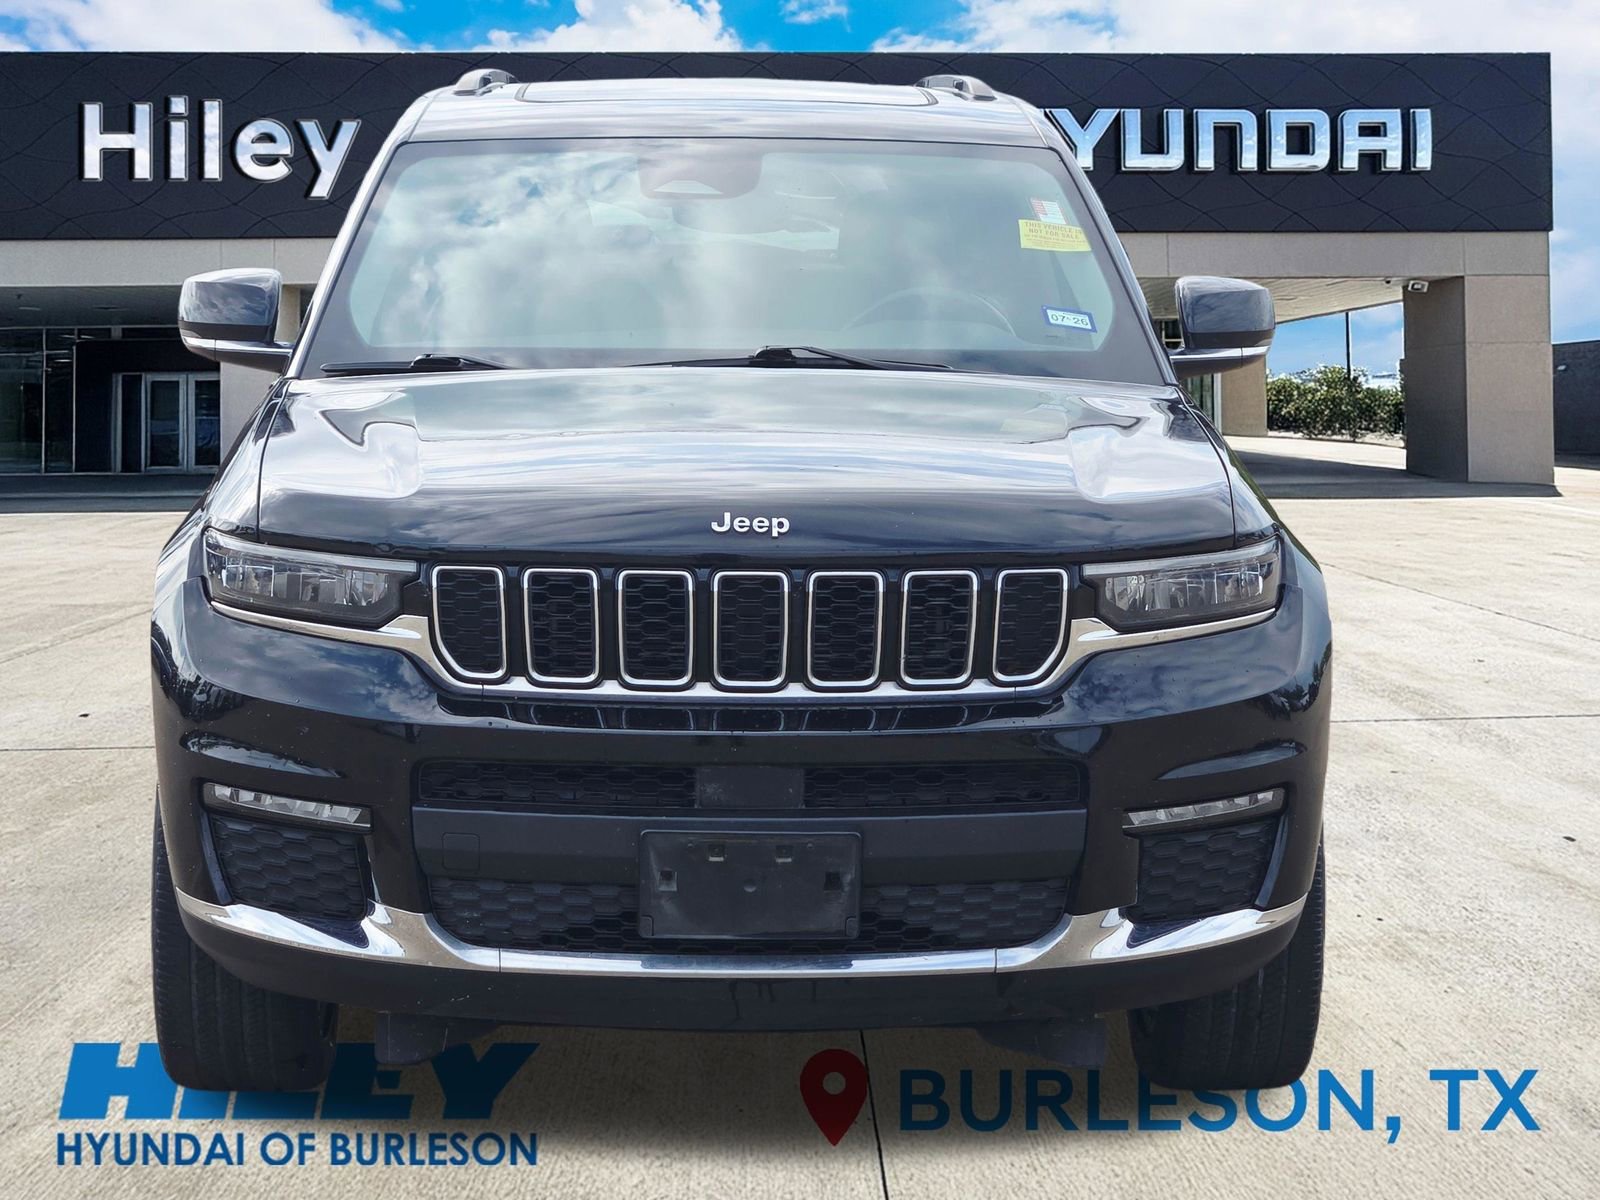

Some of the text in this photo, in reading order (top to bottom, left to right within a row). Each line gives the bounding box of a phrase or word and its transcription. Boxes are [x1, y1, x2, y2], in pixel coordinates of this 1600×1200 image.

[80, 94, 361, 199] Hiley
[1039, 107, 1432, 173] YUNDAI
[1043, 223, 1073, 233] VEHICLE
[1061, 232, 1081, 240] SALE
[710, 511, 790, 537] Jeep
